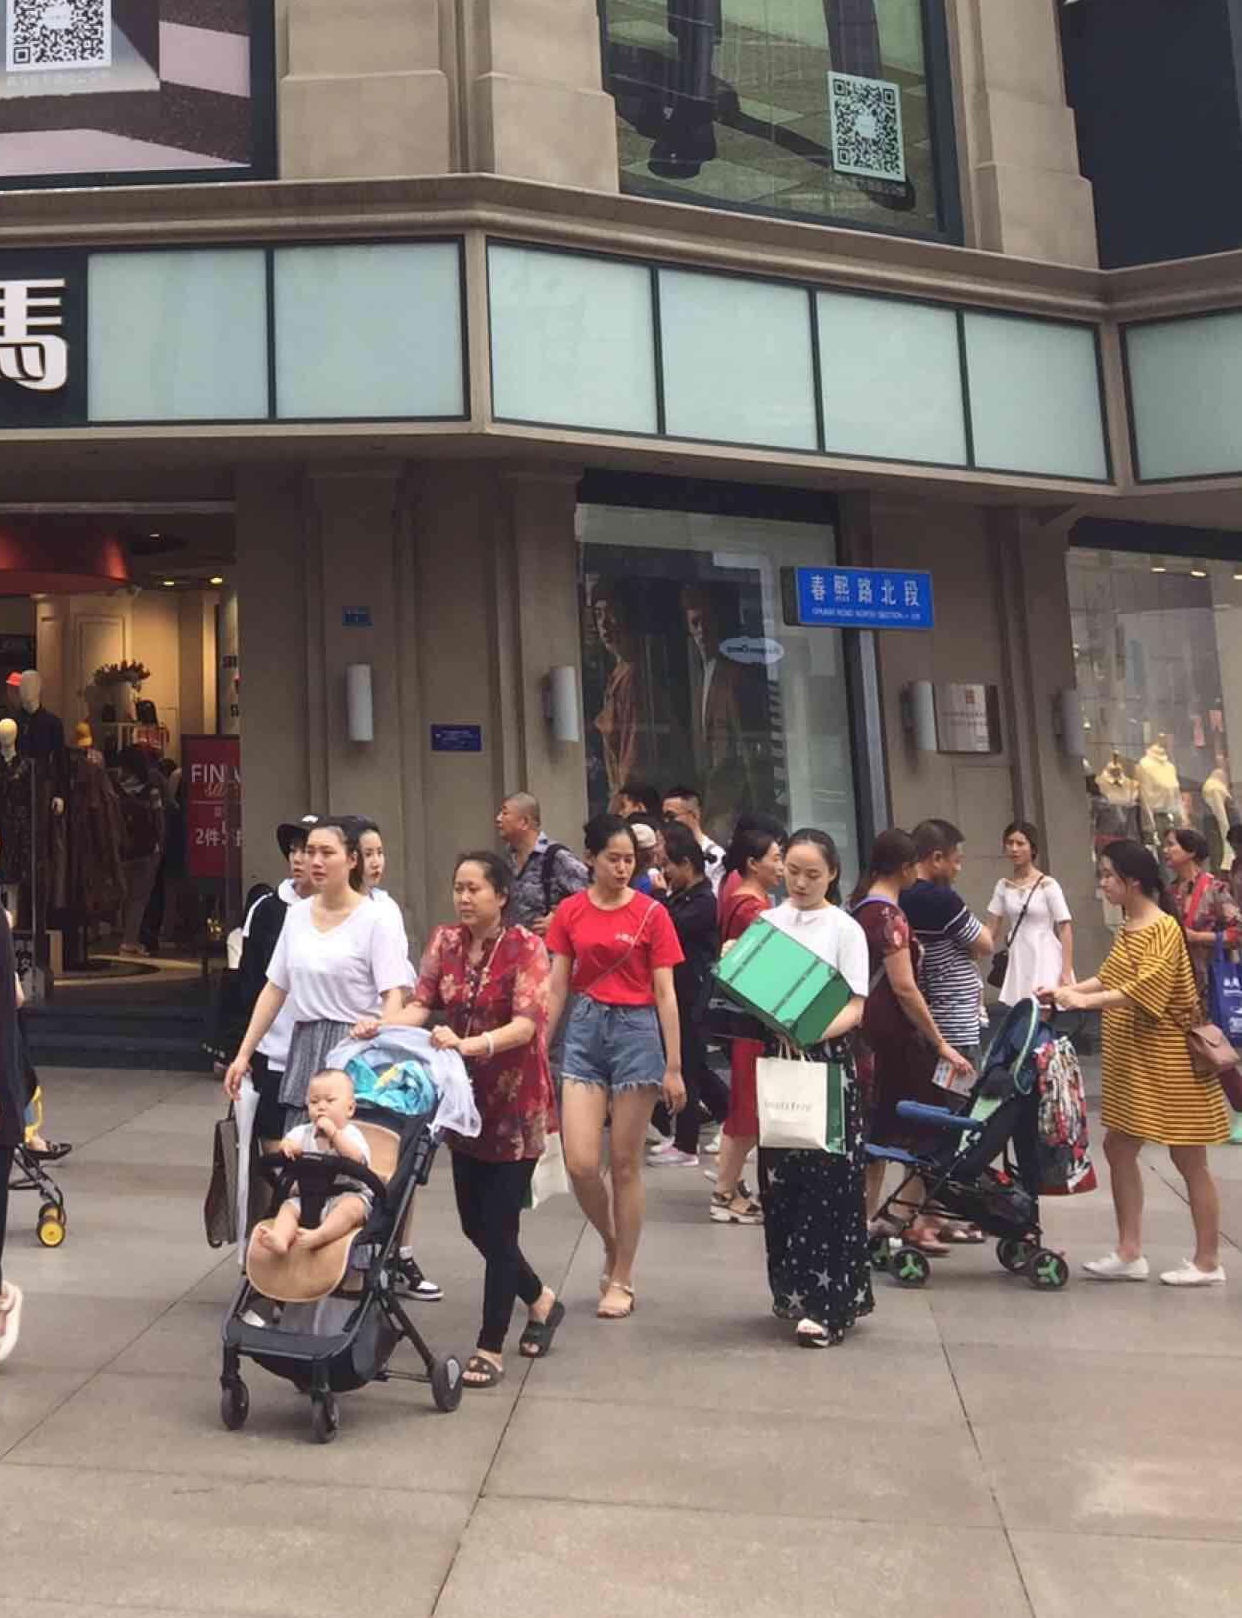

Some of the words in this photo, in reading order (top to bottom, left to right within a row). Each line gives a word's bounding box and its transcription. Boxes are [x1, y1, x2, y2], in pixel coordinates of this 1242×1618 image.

[810, 574, 920, 607] 春熙路北段
